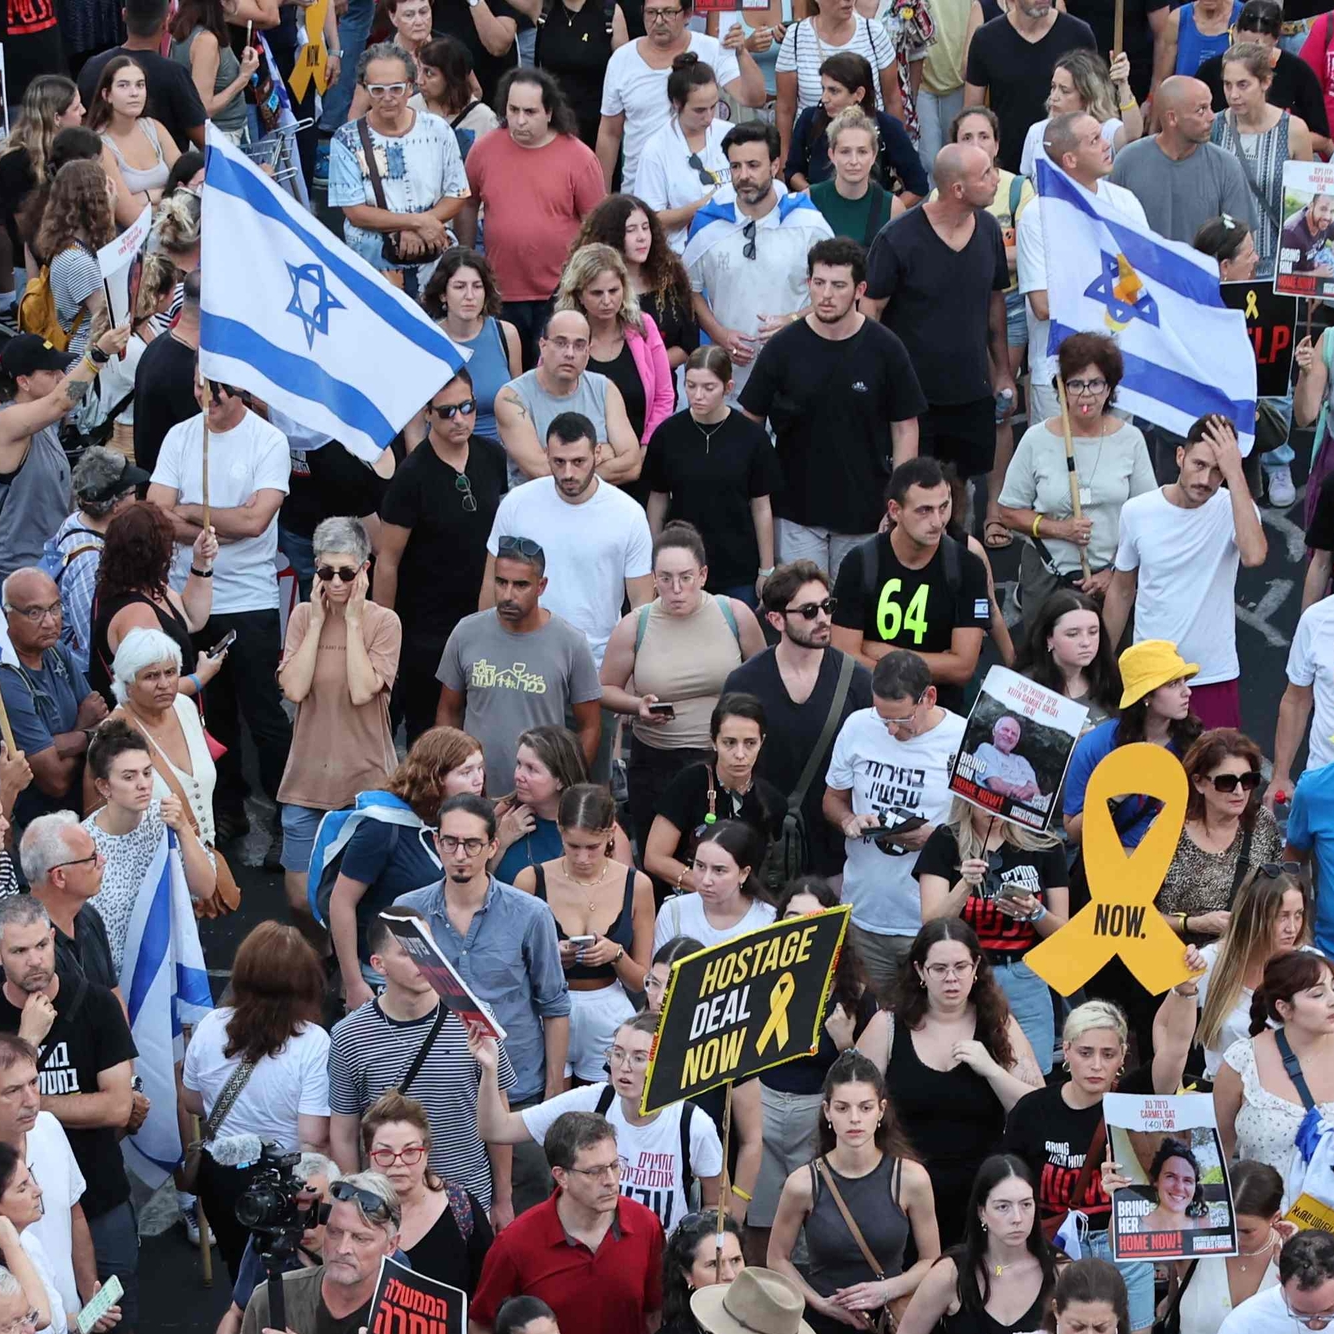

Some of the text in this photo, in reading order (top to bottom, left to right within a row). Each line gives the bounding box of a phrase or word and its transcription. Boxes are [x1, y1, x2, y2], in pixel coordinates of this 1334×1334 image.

[877, 578, 930, 644] 64
[956, 763, 976, 782] HIM
[960, 751, 987, 775] BRING
[953, 775, 1005, 812] HOME NOW!
[1093, 904, 1146, 939] NOW.
[698, 927, 817, 999] HOSTAGE
[687, 985, 750, 1041] DEAL
[679, 1027, 746, 1091] NOW
[1140, 1109, 1176, 1119] CARMEL GAT
[1117, 1200, 1149, 1217] BRING
[1117, 1216, 1139, 1234] HER
[1119, 1230, 1183, 1251] HOME NOW!
[384, 1277, 448, 1321] הממשלה
